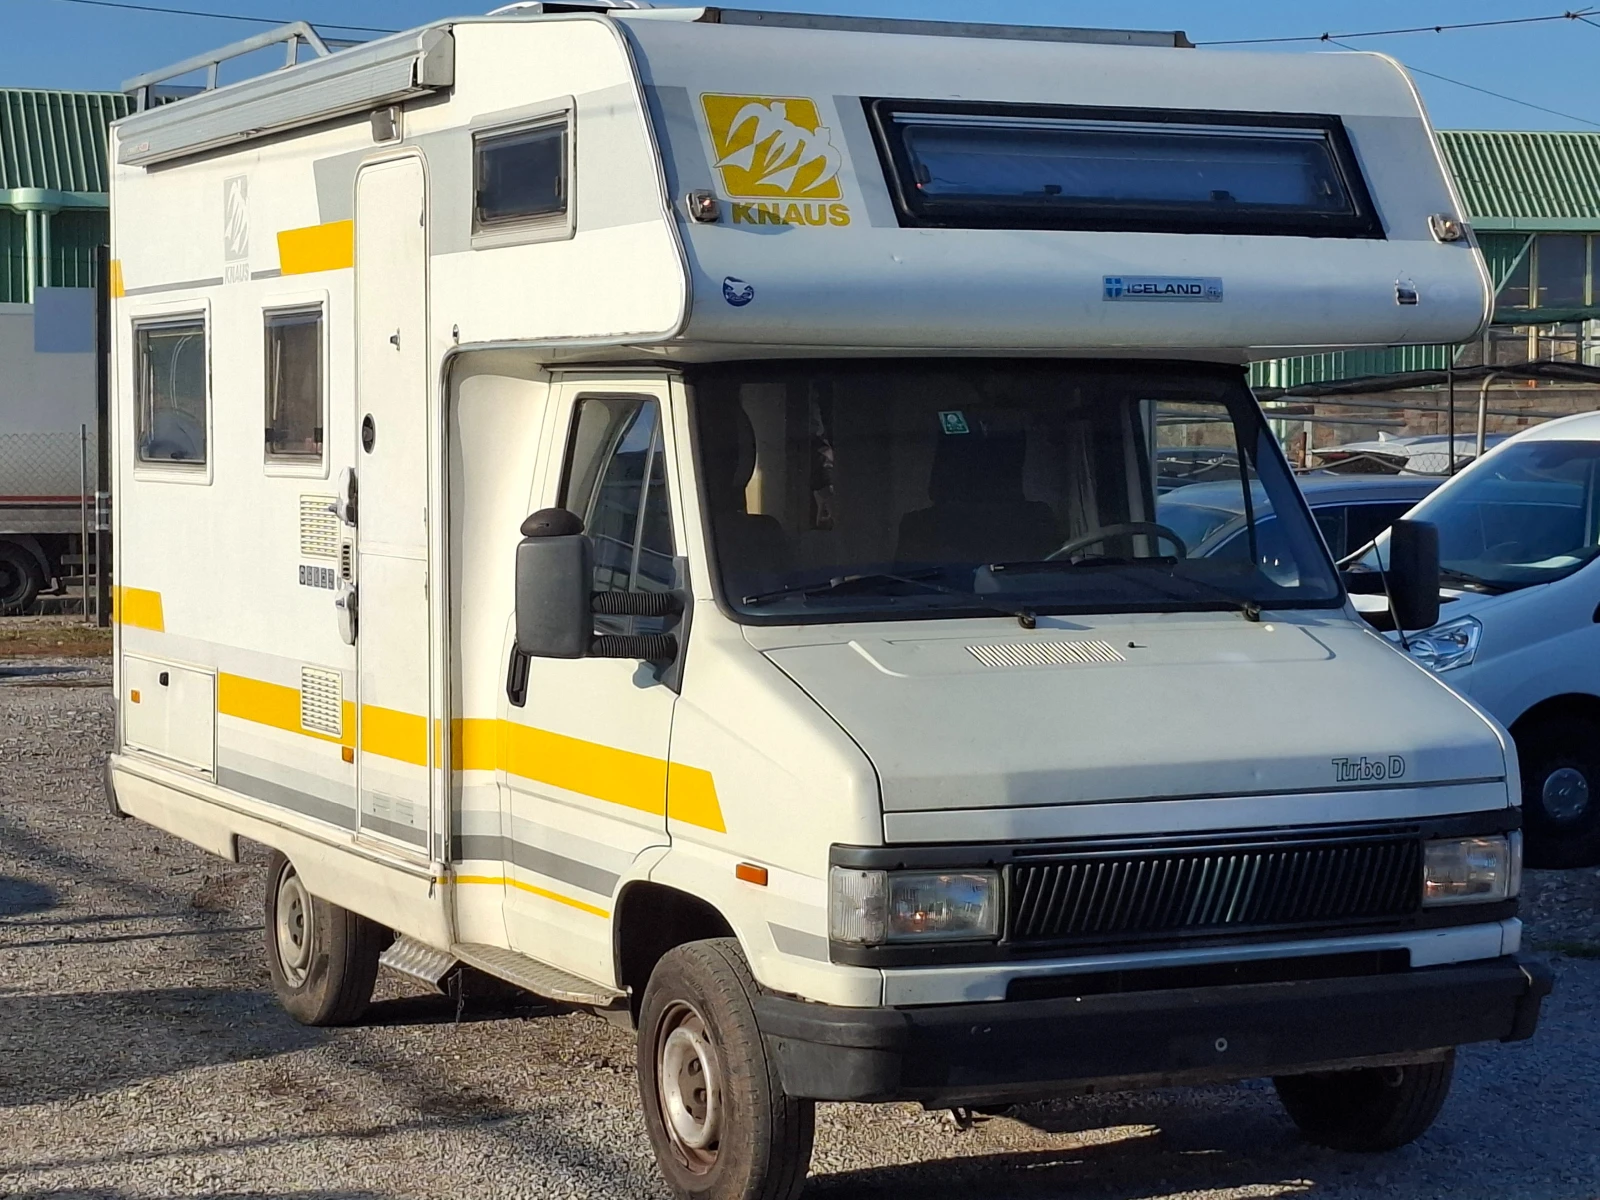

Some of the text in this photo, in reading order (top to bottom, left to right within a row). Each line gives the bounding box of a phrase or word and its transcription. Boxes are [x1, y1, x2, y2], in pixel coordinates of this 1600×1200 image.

[731, 202, 851, 226] KNAUS
[224, 263, 250, 285] KNAUS
[1126, 283, 1202, 295] ICELAND
[1331, 755, 1406, 782] Turbo D
